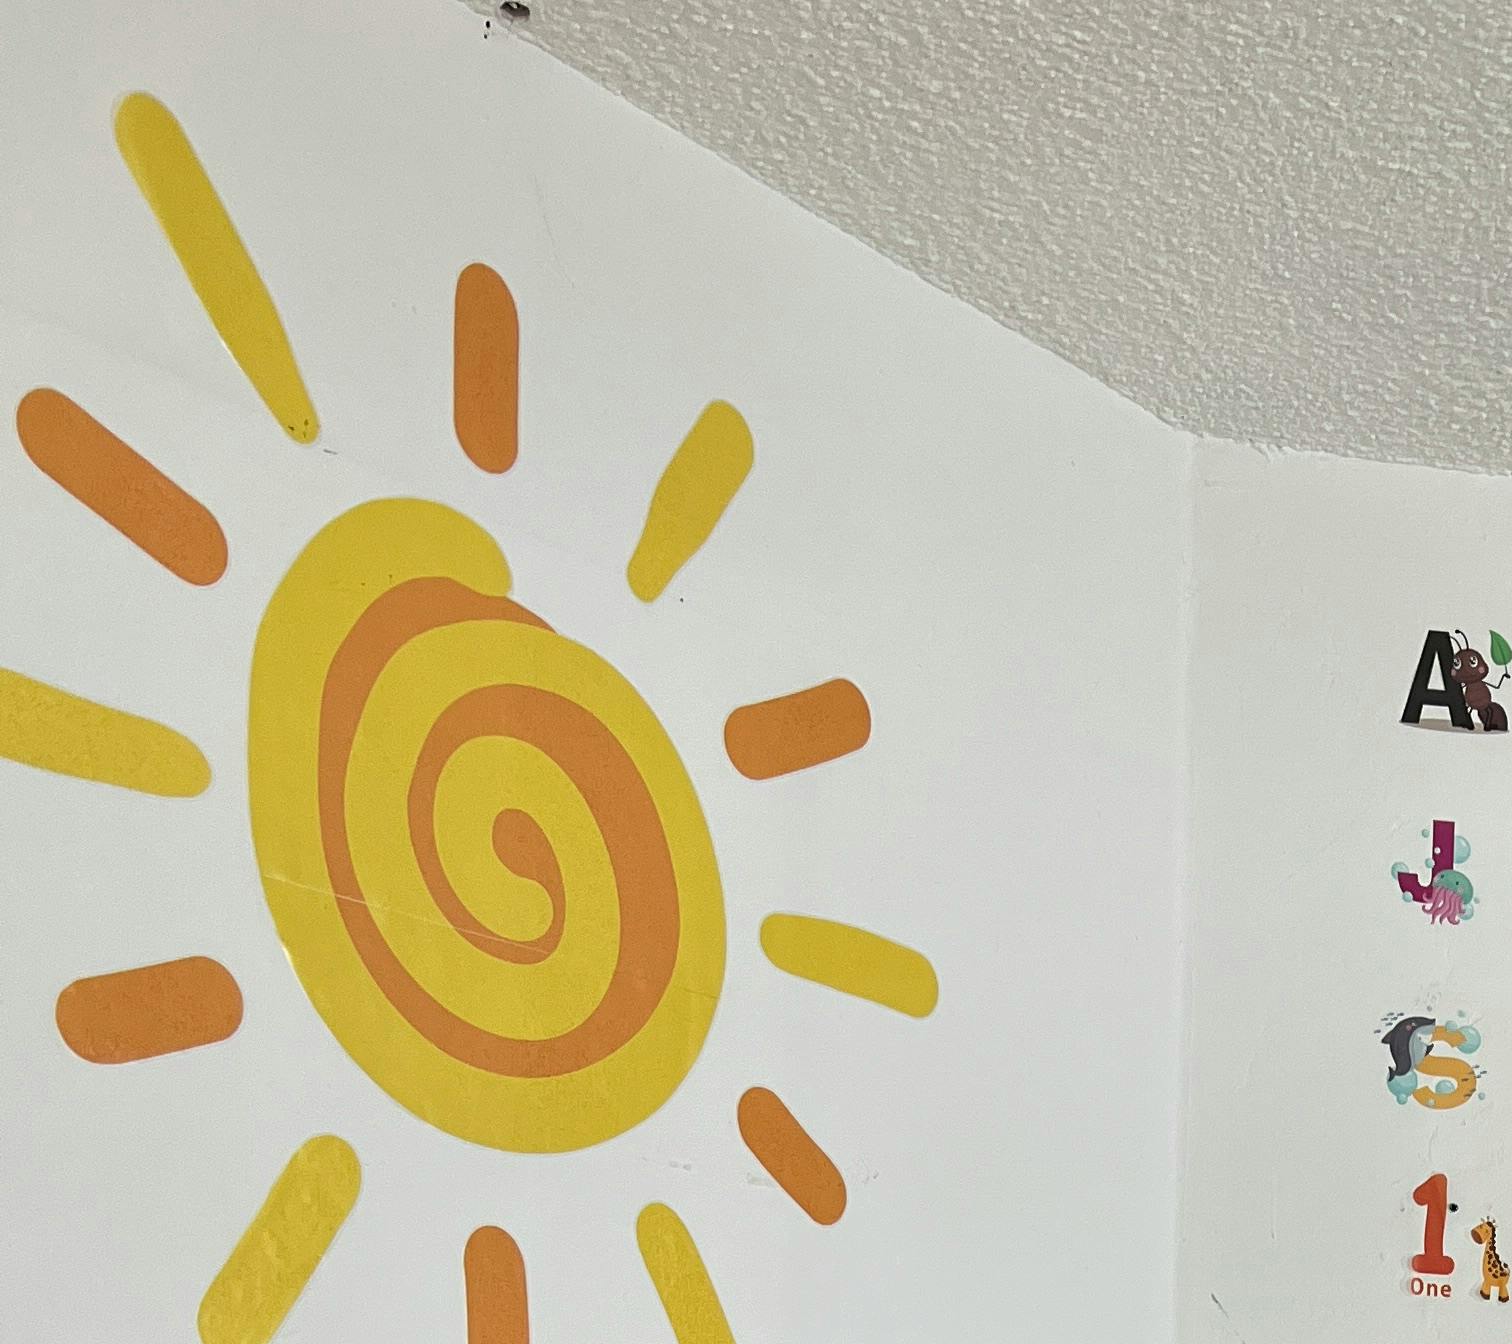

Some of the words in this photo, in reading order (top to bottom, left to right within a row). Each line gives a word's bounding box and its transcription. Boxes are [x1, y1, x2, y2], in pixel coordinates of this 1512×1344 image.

[1400, 630, 1474, 730] A
[1398, 820, 1455, 904] J
[1412, 1025, 1477, 1110] S
[1411, 1173, 1455, 1275] 1
[1410, 1278, 1452, 1298] One
